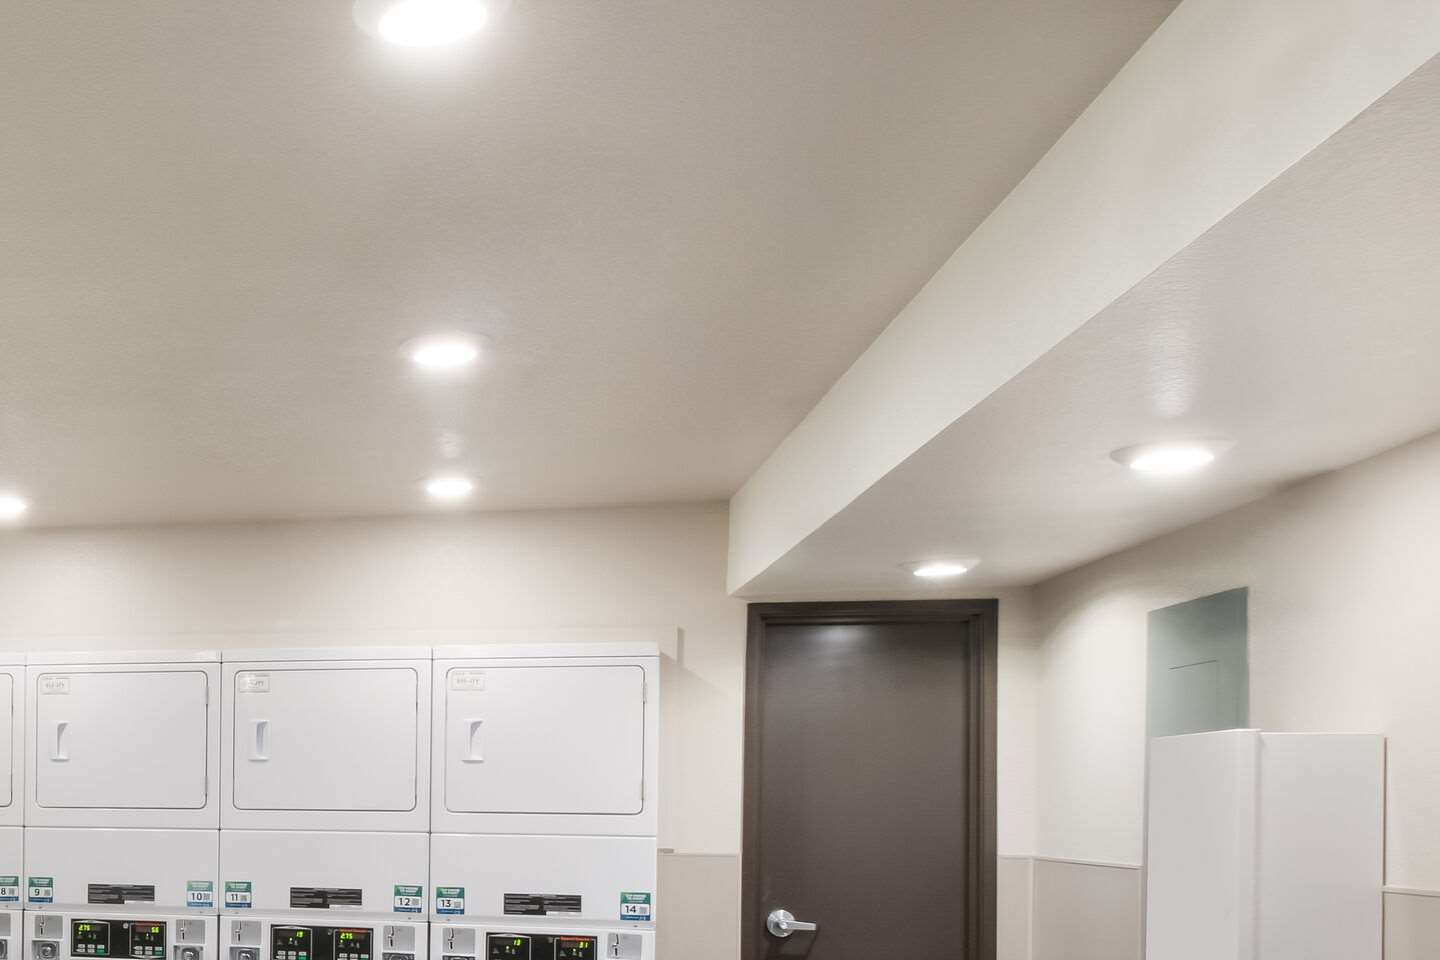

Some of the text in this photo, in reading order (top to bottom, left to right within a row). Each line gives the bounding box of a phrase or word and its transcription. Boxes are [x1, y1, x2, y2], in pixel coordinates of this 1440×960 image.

[191, 892, 203, 900] 10
[231, 893, 238, 901] 11
[399, 898, 410, 906] 12
[441, 899, 451, 908] 13
[625, 905, 636, 913] 14
